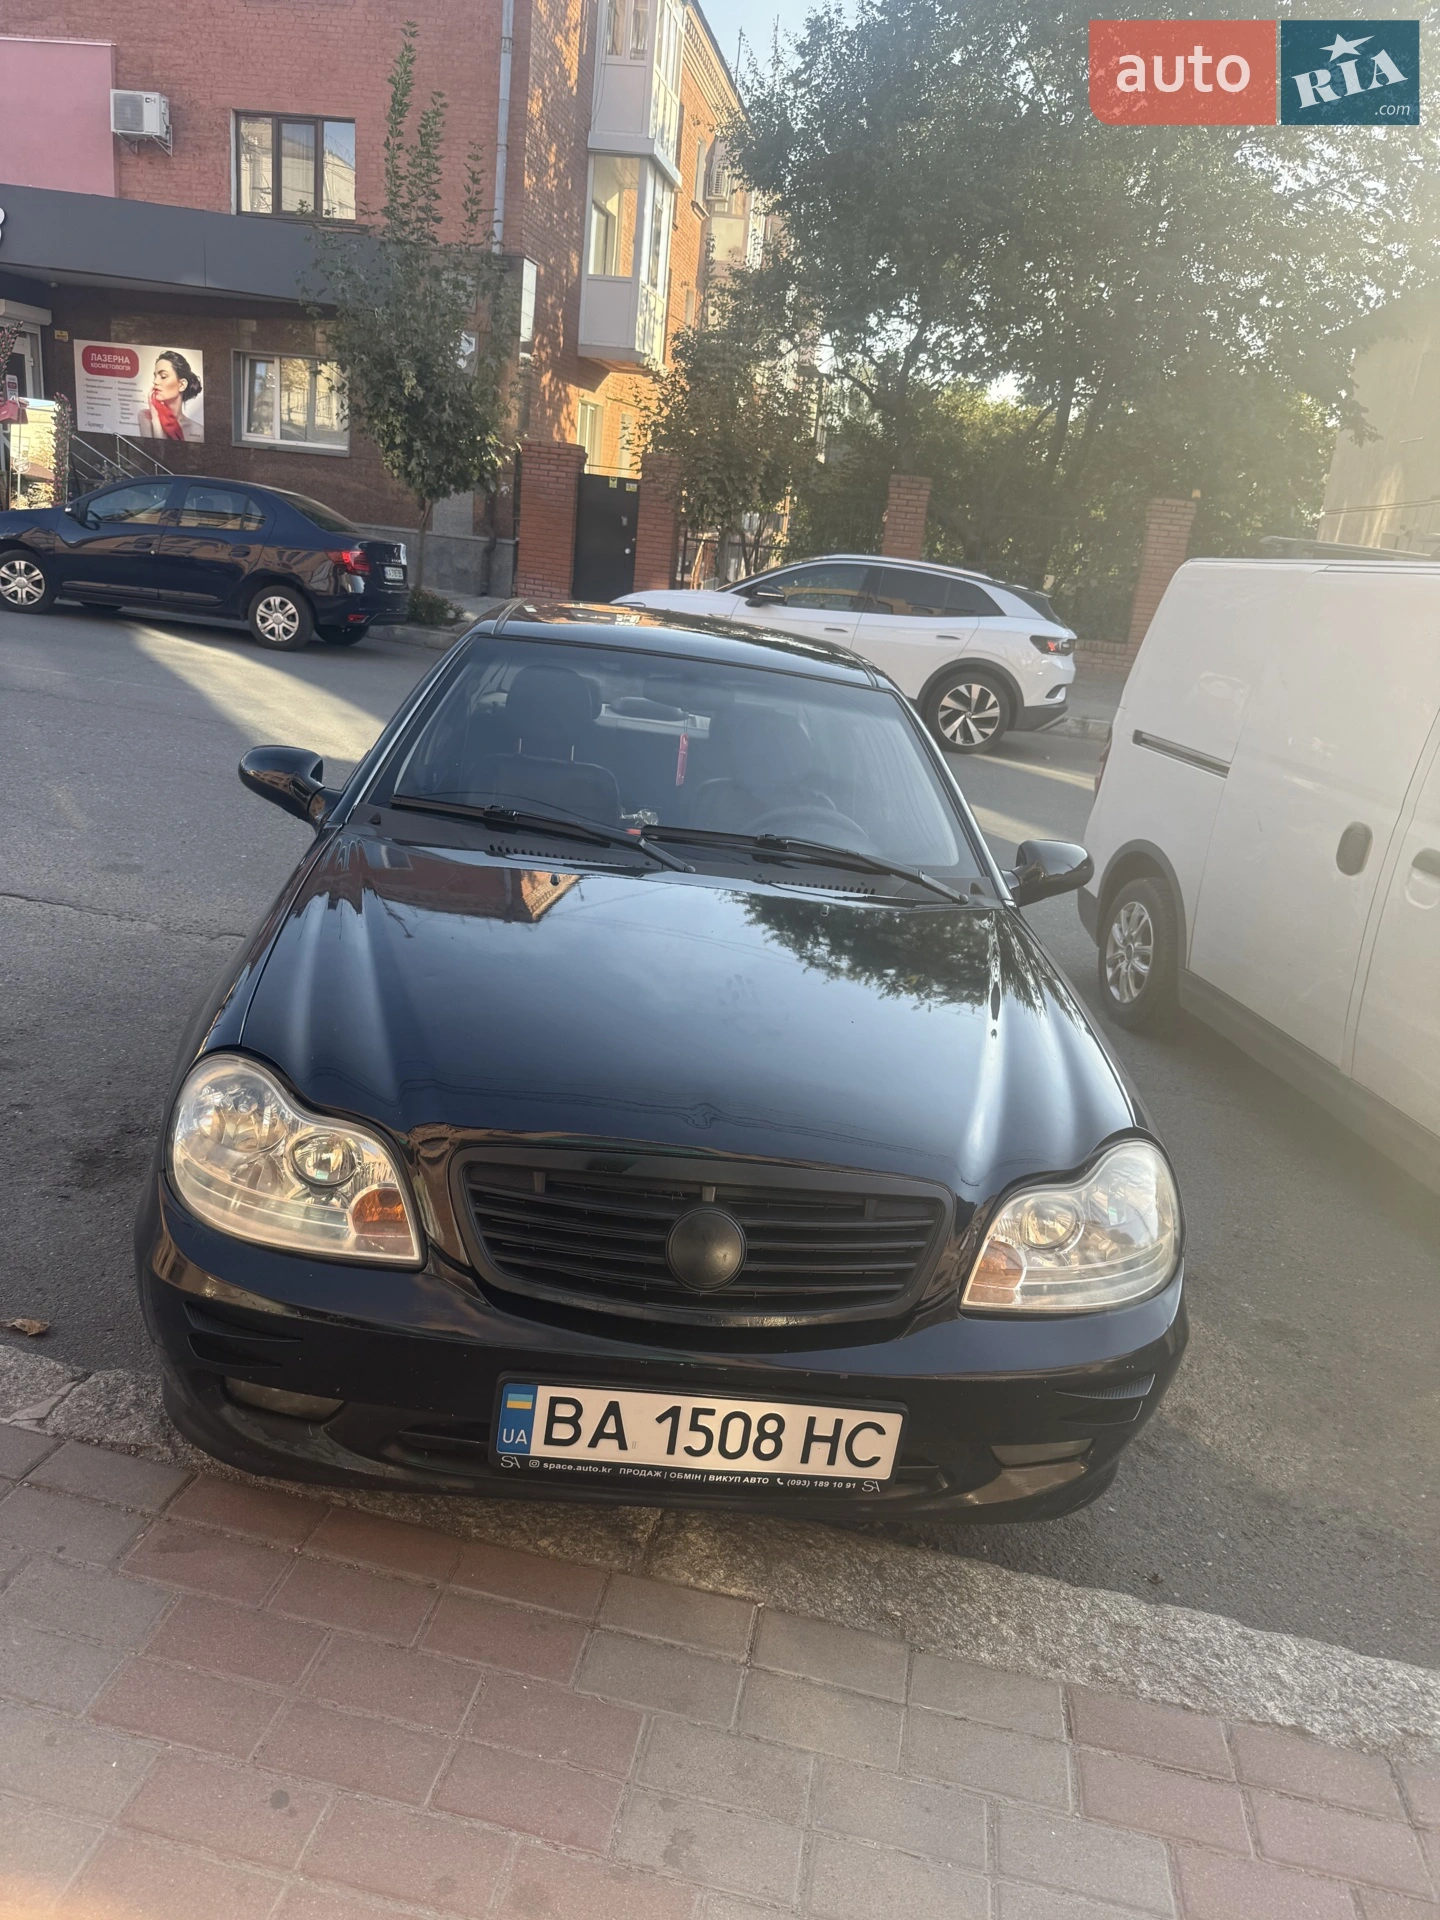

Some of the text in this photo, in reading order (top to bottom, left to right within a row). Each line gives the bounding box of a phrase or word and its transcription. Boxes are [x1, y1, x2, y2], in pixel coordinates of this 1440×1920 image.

[90, 353, 131, 365] ЛАЗЕРНА
[90, 362, 132, 372] КОСМЕТОЛОГІЯ
[502, 1428, 529, 1445] UA
[542, 1396, 887, 1469] BA 1508 HC
[543, 1461, 613, 1475] space.auto.kr
[619, 1467, 770, 1484] ПРОДАЖ ОБМІН ВИКУП АВТО
[786, 1478, 811, 1488] (093)
[813, 1480, 830, 1488] 189
[832, 1481, 843, 1489] 10
